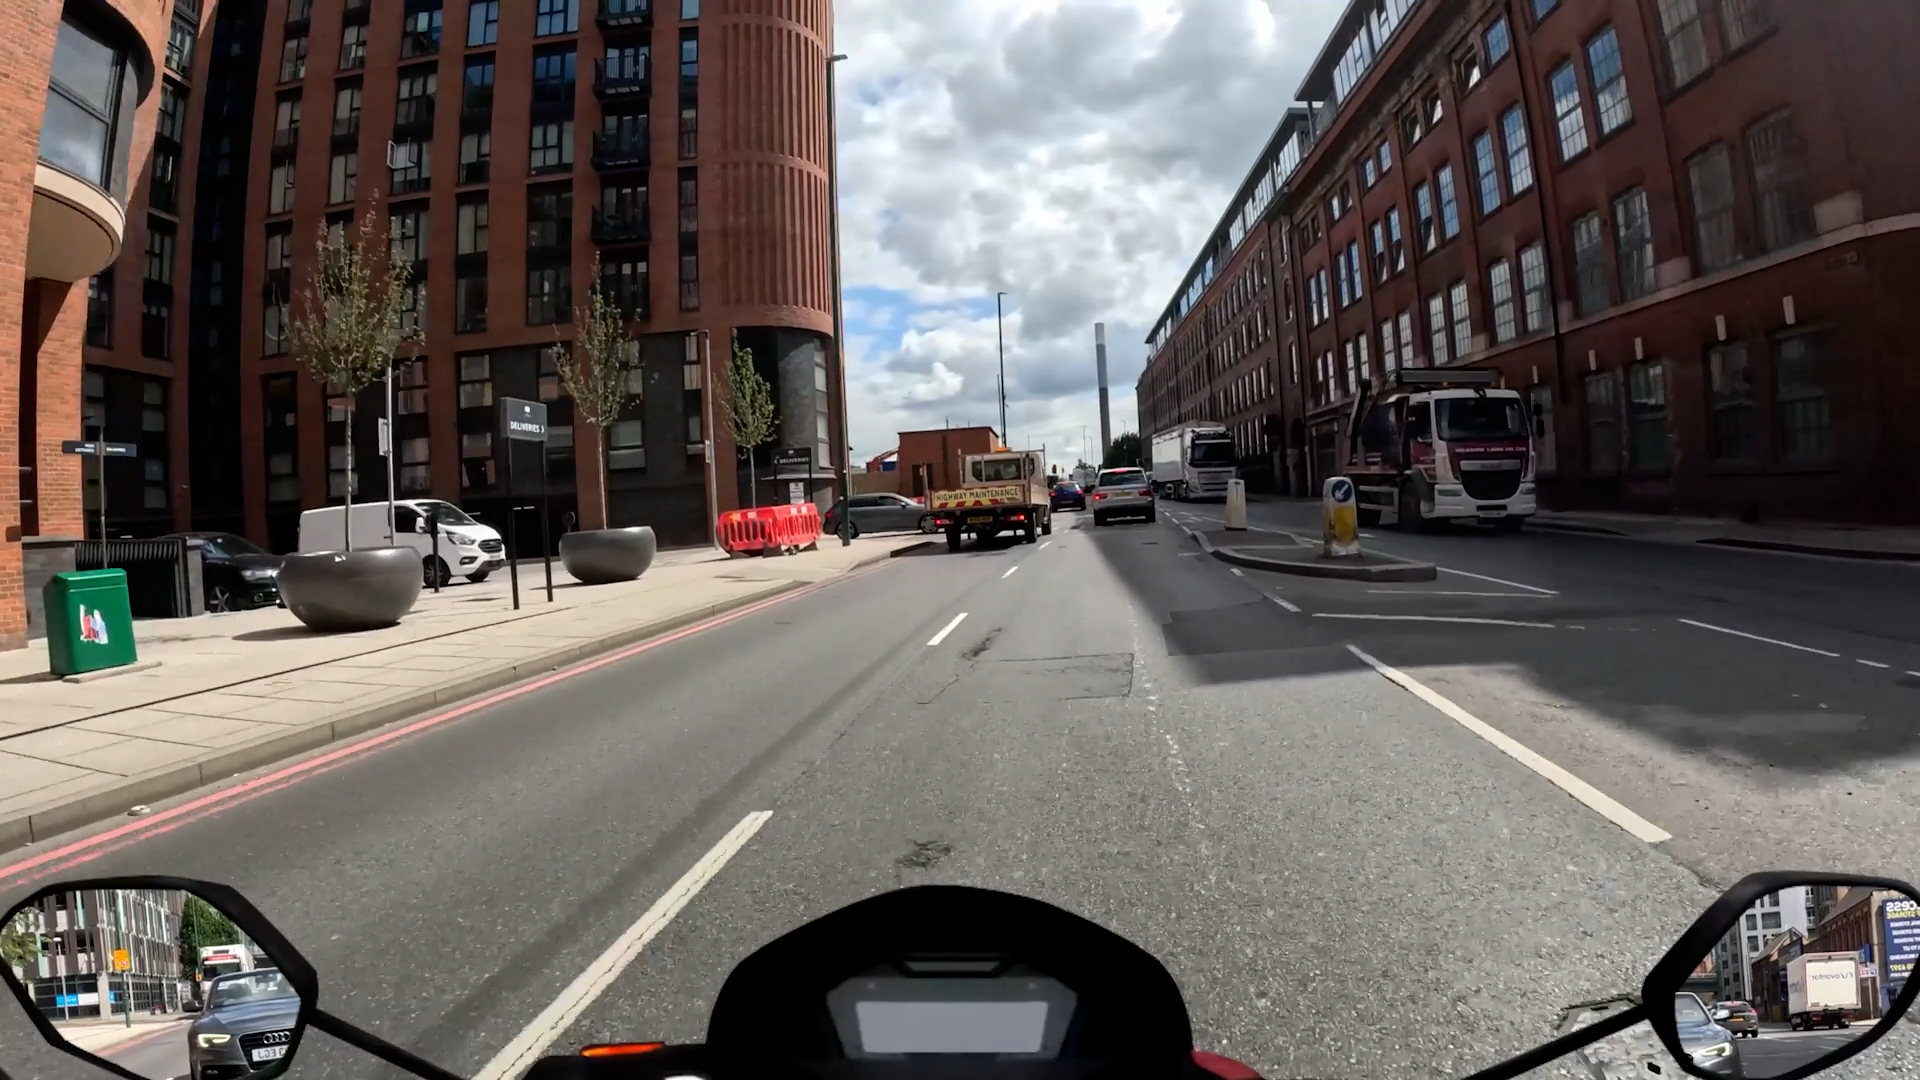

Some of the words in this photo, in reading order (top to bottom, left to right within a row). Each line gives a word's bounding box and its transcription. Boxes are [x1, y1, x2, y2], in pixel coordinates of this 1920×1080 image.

[510, 421, 540, 433] DELIVERIES
[936, 492, 968, 501] HIGHWAY
[969, 487, 1019, 498] MAINTENANCE
